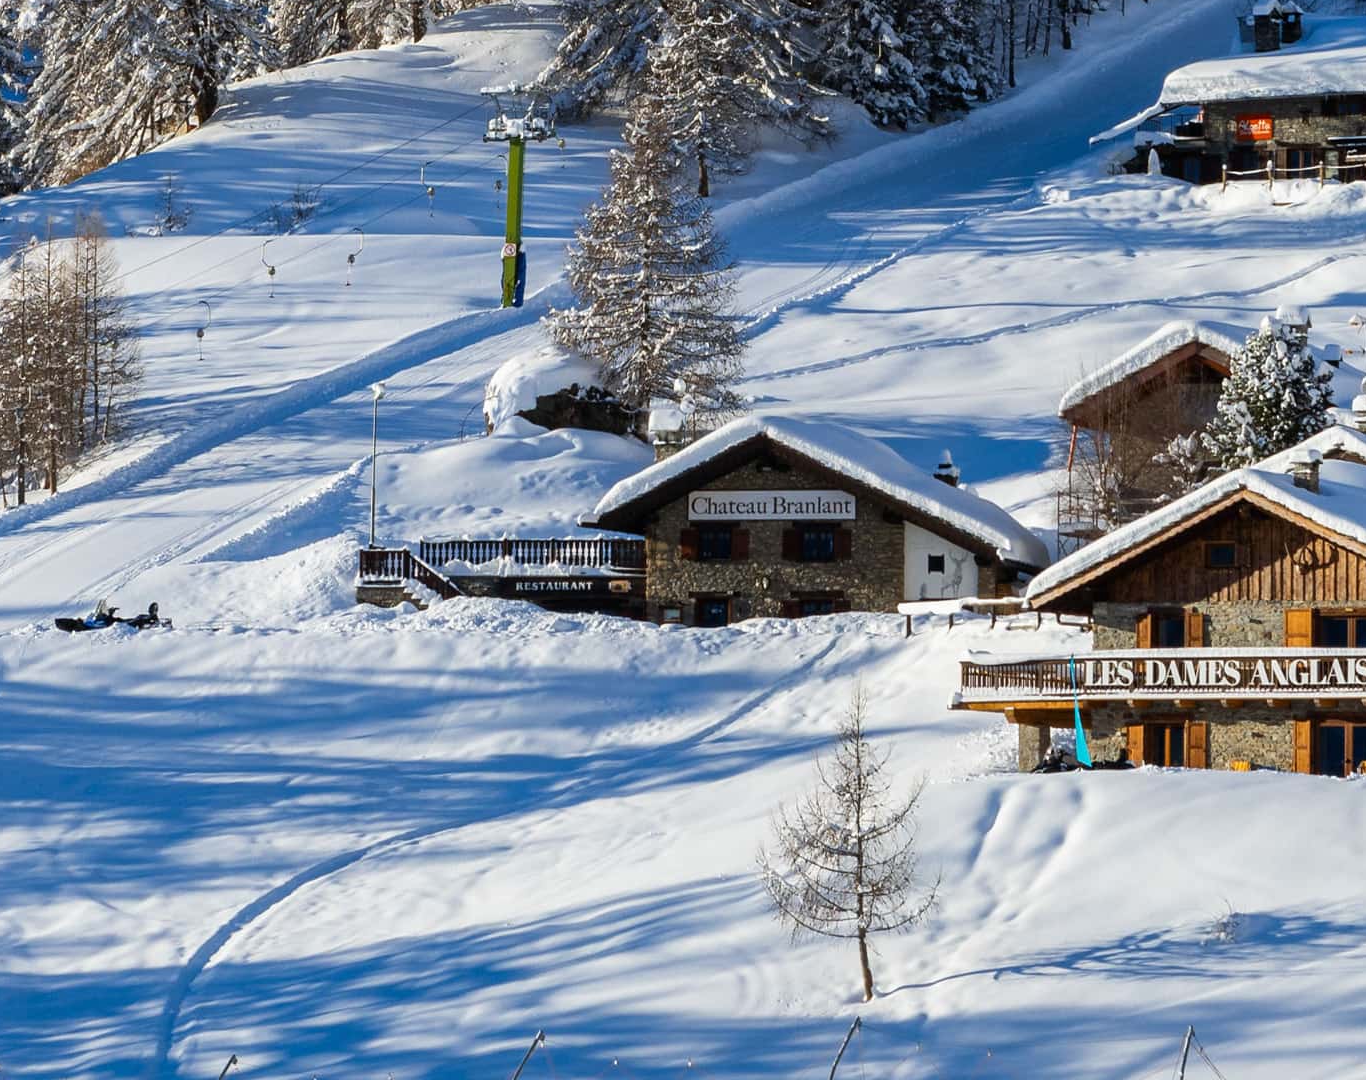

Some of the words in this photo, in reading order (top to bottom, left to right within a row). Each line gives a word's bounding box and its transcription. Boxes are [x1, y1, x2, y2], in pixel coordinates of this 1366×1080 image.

[691, 496, 767, 515] Chateau
[772, 496, 852, 515] Branlant
[515, 581, 593, 591] RESTAURANT
[1085, 660, 1134, 687] LES
[1145, 659, 1240, 687] DAMES
